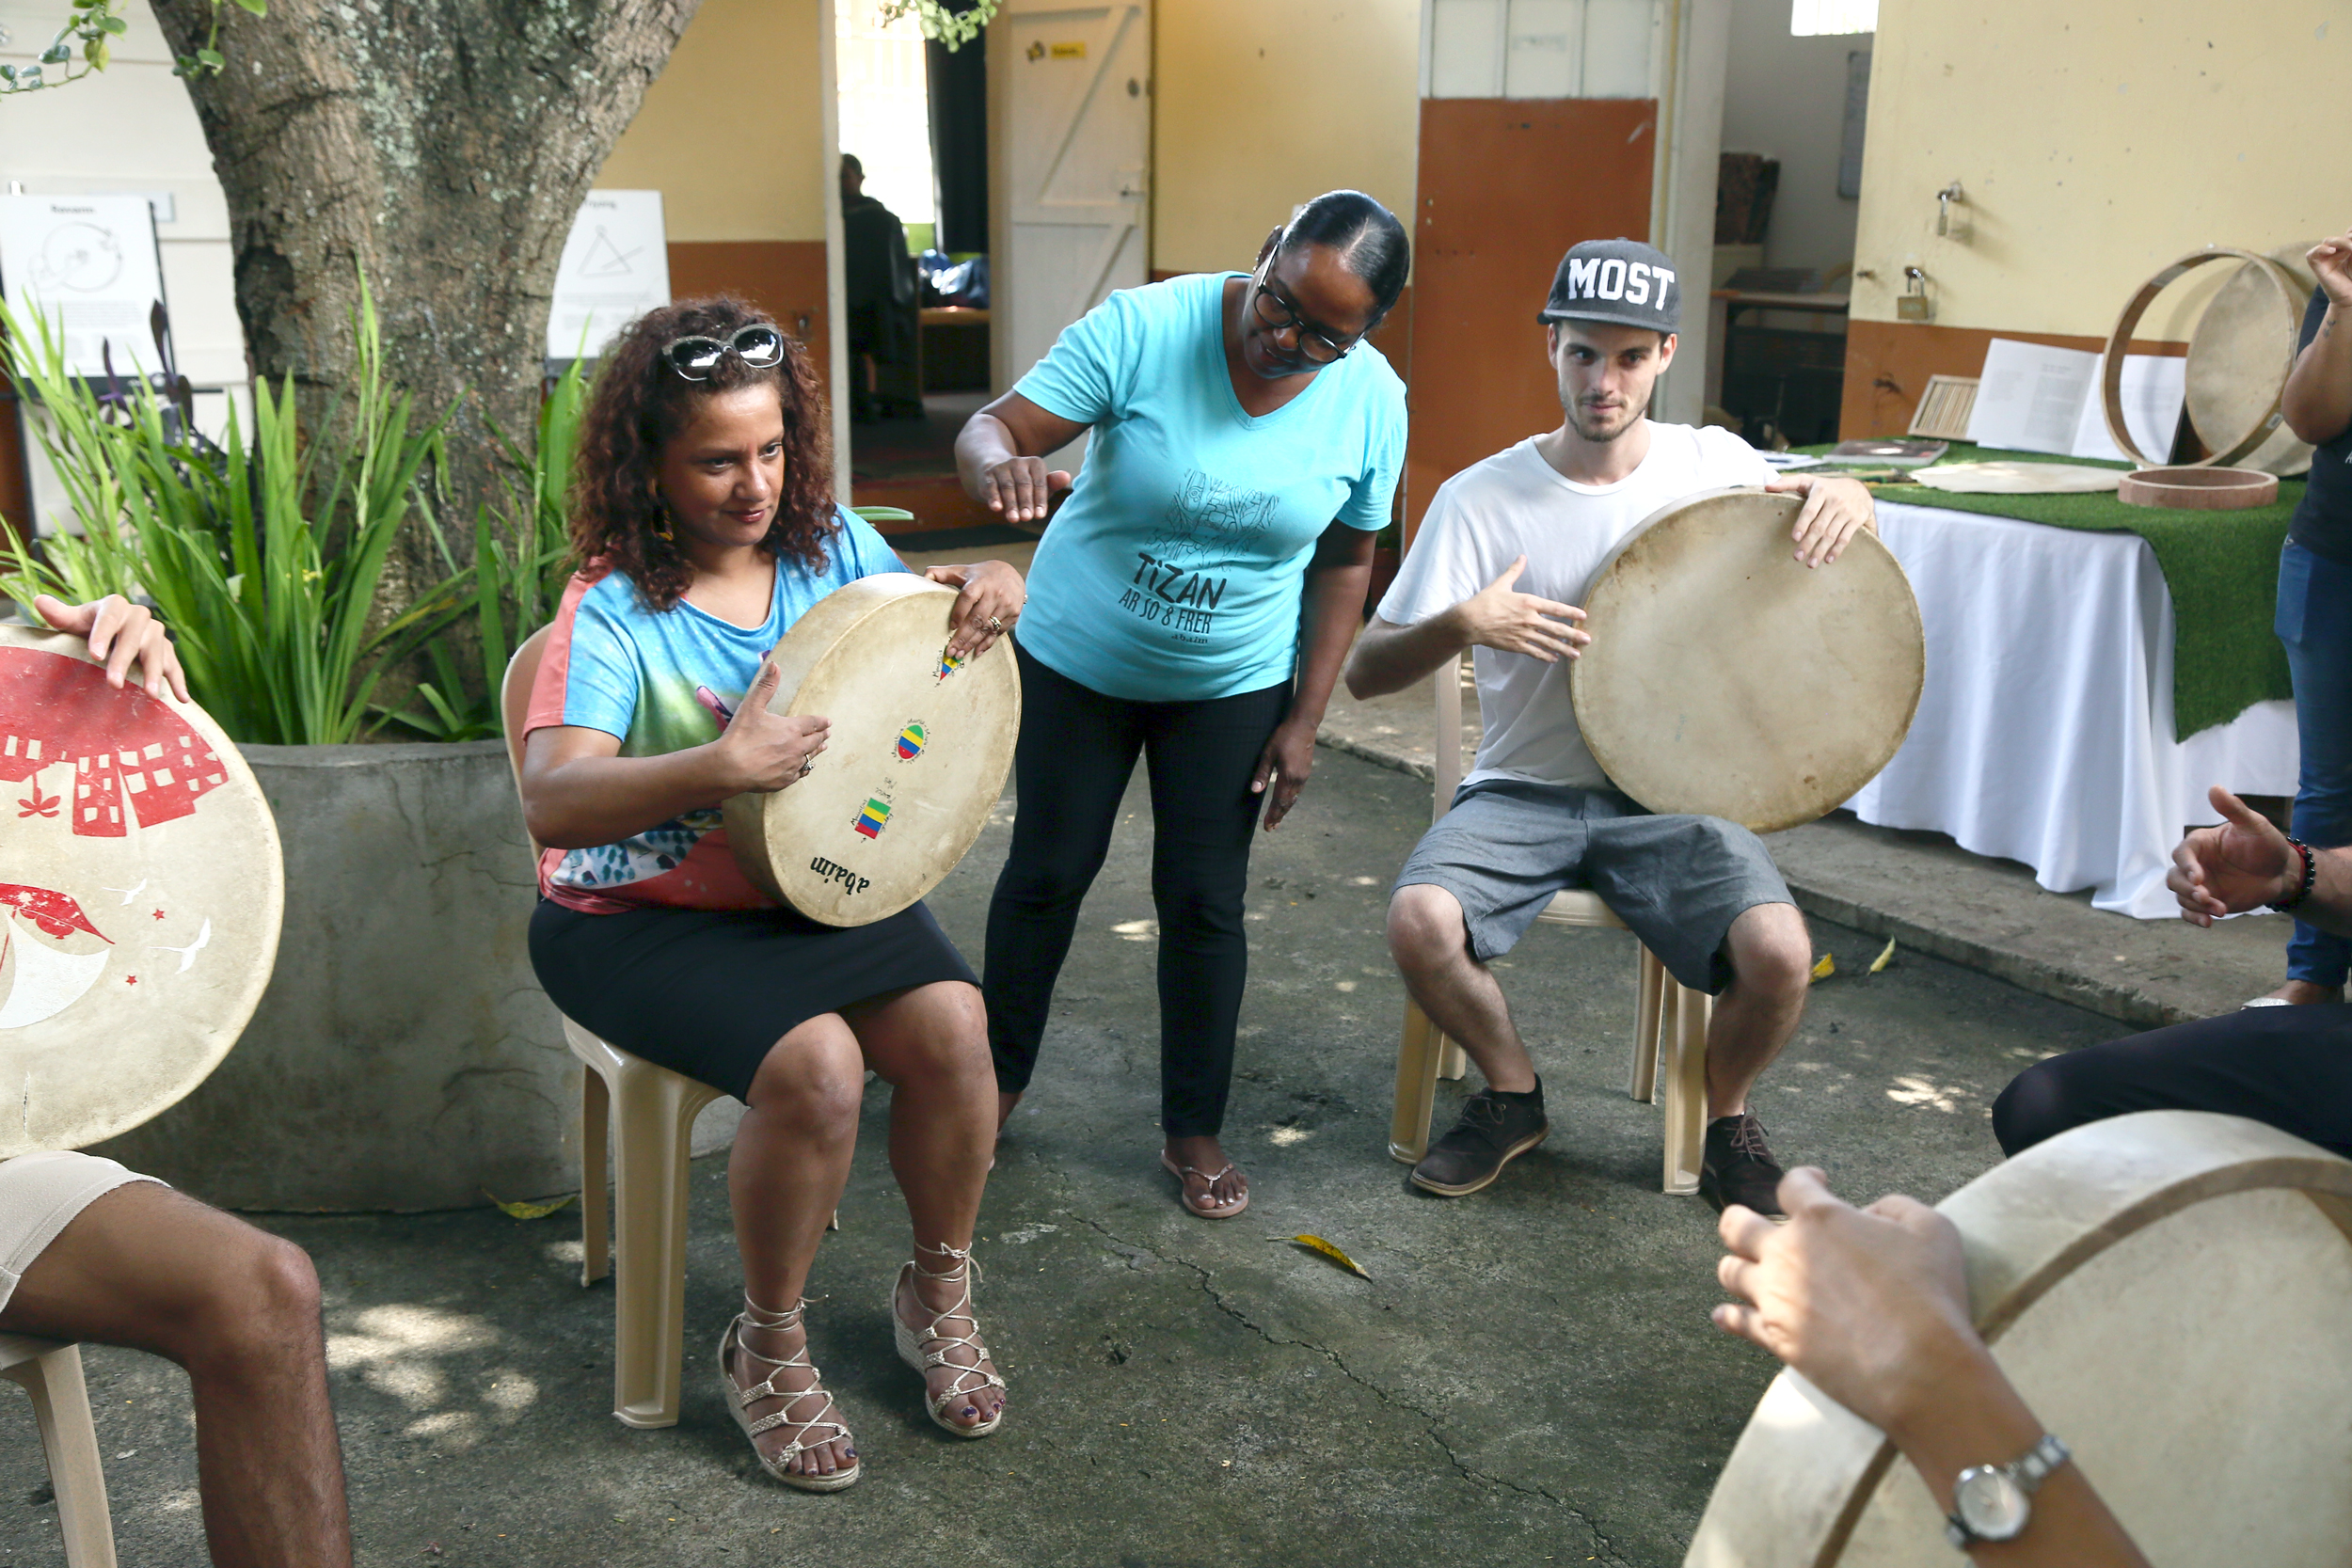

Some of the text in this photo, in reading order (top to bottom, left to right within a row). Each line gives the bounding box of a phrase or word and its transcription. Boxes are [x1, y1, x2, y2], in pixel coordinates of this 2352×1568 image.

[1568, 258, 1676, 311] MOST
[1119, 588, 1140, 612] AR
[1138, 598, 1160, 621] SO
[1175, 609, 1213, 634] FRER
[1171, 634, 1208, 644] abaim
[810, 856, 870, 895] abaim
